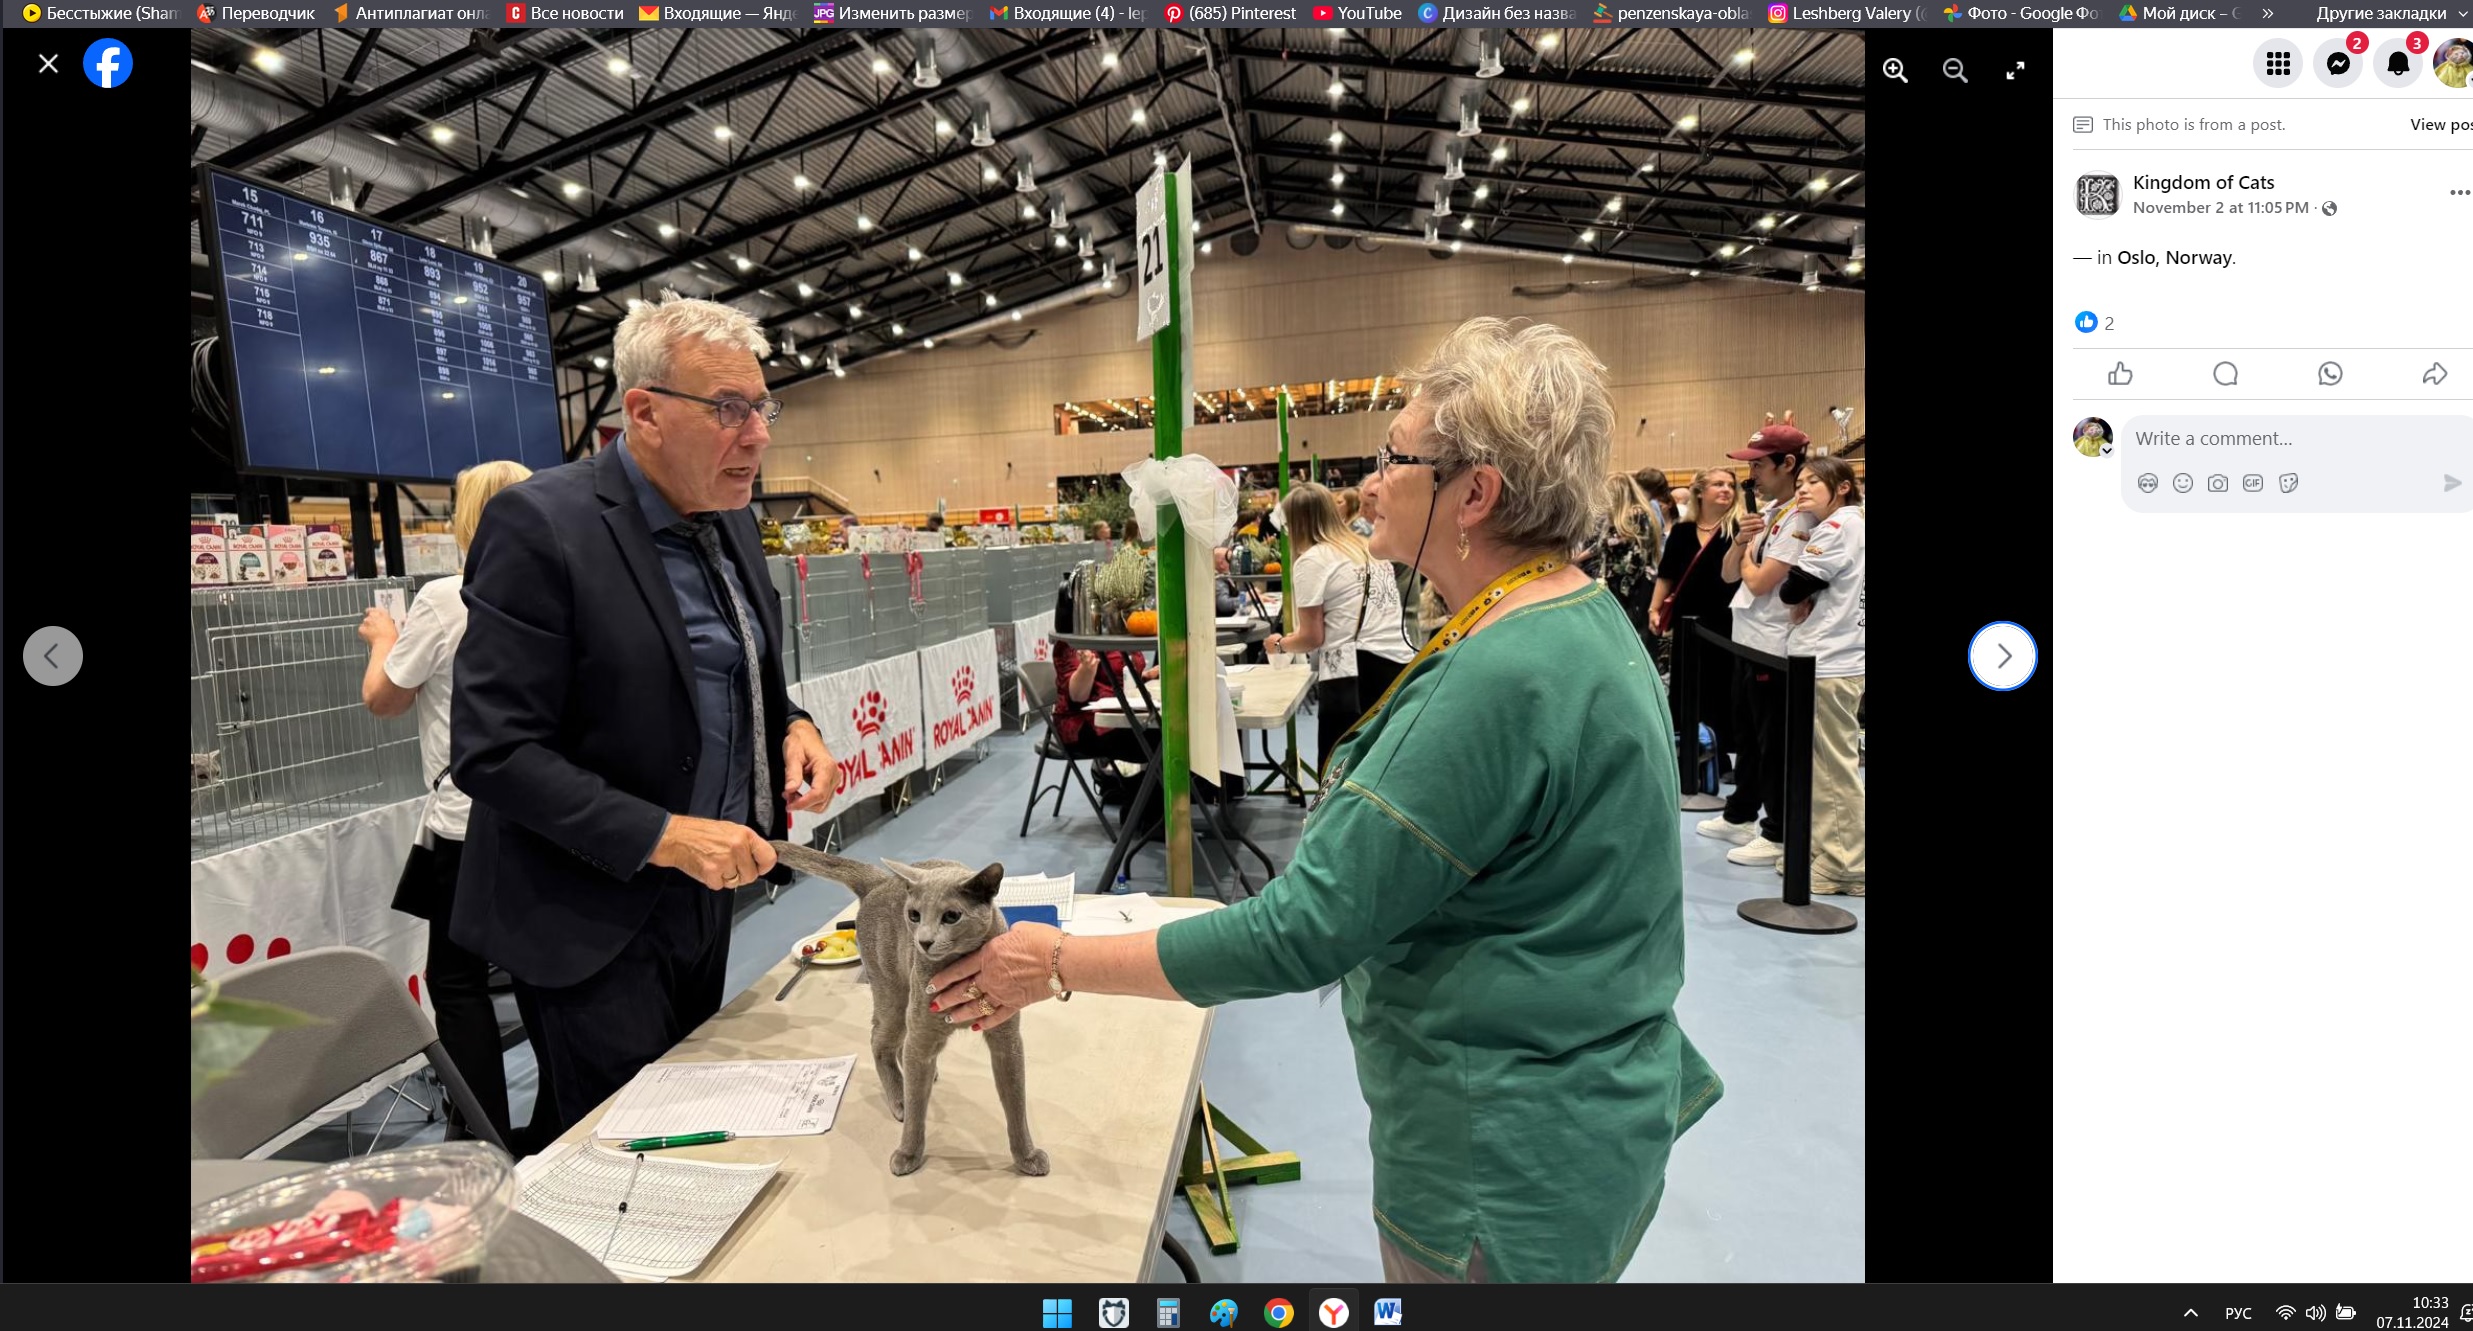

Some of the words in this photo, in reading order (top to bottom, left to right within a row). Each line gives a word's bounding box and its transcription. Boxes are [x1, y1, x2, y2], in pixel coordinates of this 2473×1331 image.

[48, 7, 133, 20] Бесстыжие
[223, 7, 315, 22] Переводчик
[356, 7, 455, 20] Антиплагиат
[532, 7, 558, 19] Все
[563, 10, 623, 19] новости
[665, 7, 741, 21] Входящие
[814, 7, 834, 19] JPG
[840, 7, 915, 20] Изменить
[1015, 7, 1091, 21] Входящие
[1096, 6, 1114, 21] (4)
[1190, 6, 1227, 21] (685)
[1232, 7, 1296, 20] Pinterest
[1338, 7, 1402, 19] YouTube
[1443, 7, 1500, 22] Дизайн
[1504, 6, 1530, 19] без
[1794, 7, 1861, 22] Leshberg
[1865, 7, 1912, 22] Valery
[1968, 7, 2007, 20] Фото
[2020, 7, 2073, 22] Google
[2144, 7, 2175, 19] Мой
[2180, 10, 2216, 22] диск
[2317, 7, 2373, 22] Другие
[2377, 9, 2447, 21] закладки
[2352, 37, 2362, 50] 2
[2413, 37, 2422, 50] 3
[2103, 118, 2131, 131] This
[2137, 118, 2179, 134] photo
[2185, 118, 2194, 131] is
[2199, 118, 2232, 131] from
[2238, 121, 2246, 131] a
[2252, 119, 2286, 134] post.
[2410, 118, 2446, 131] View
[2134, 174, 2210, 193] Kingdom
[2216, 174, 2234, 189] of
[2239, 175, 2275, 189] Cats
[242, 187, 258, 203] 15
[2134, 201, 2211, 213] November
[2216, 201, 2225, 213] 2
[2229, 203, 2243, 213] at
[2248, 202, 2283, 213] 11:05
[2286, 202, 2309, 213] PM
[241, 211, 263, 229] 711
[310, 209, 325, 224] 16
[309, 231, 331, 249] 935
[370, 228, 383, 241] 17
[248, 240, 265, 253] 713
[424, 246, 436, 259] 18
[369, 249, 388, 264] 867
[1142, 226, 1163, 286] 21
[2098, 250, 2112, 265] in
[2118, 250, 2160, 268] Oslo,
[2167, 250, 2236, 268] Norway.
[251, 263, 267, 275] 714
[423, 265, 441, 281] 893
[2105, 316, 2115, 331] 2
[2136, 430, 2180, 445] Write
[2186, 434, 2195, 445] a
[2201, 432, 2292, 446] comment...
[933, 713, 967, 750] ROYAL
[836, 749, 877, 795] OYAL
[878, 731, 913, 770] ANIN
[2414, 1297, 2449, 1309] 10:33
[2226, 1308, 2252, 1320] РУС
[2377, 1317, 2450, 1329] 07.11.2024
